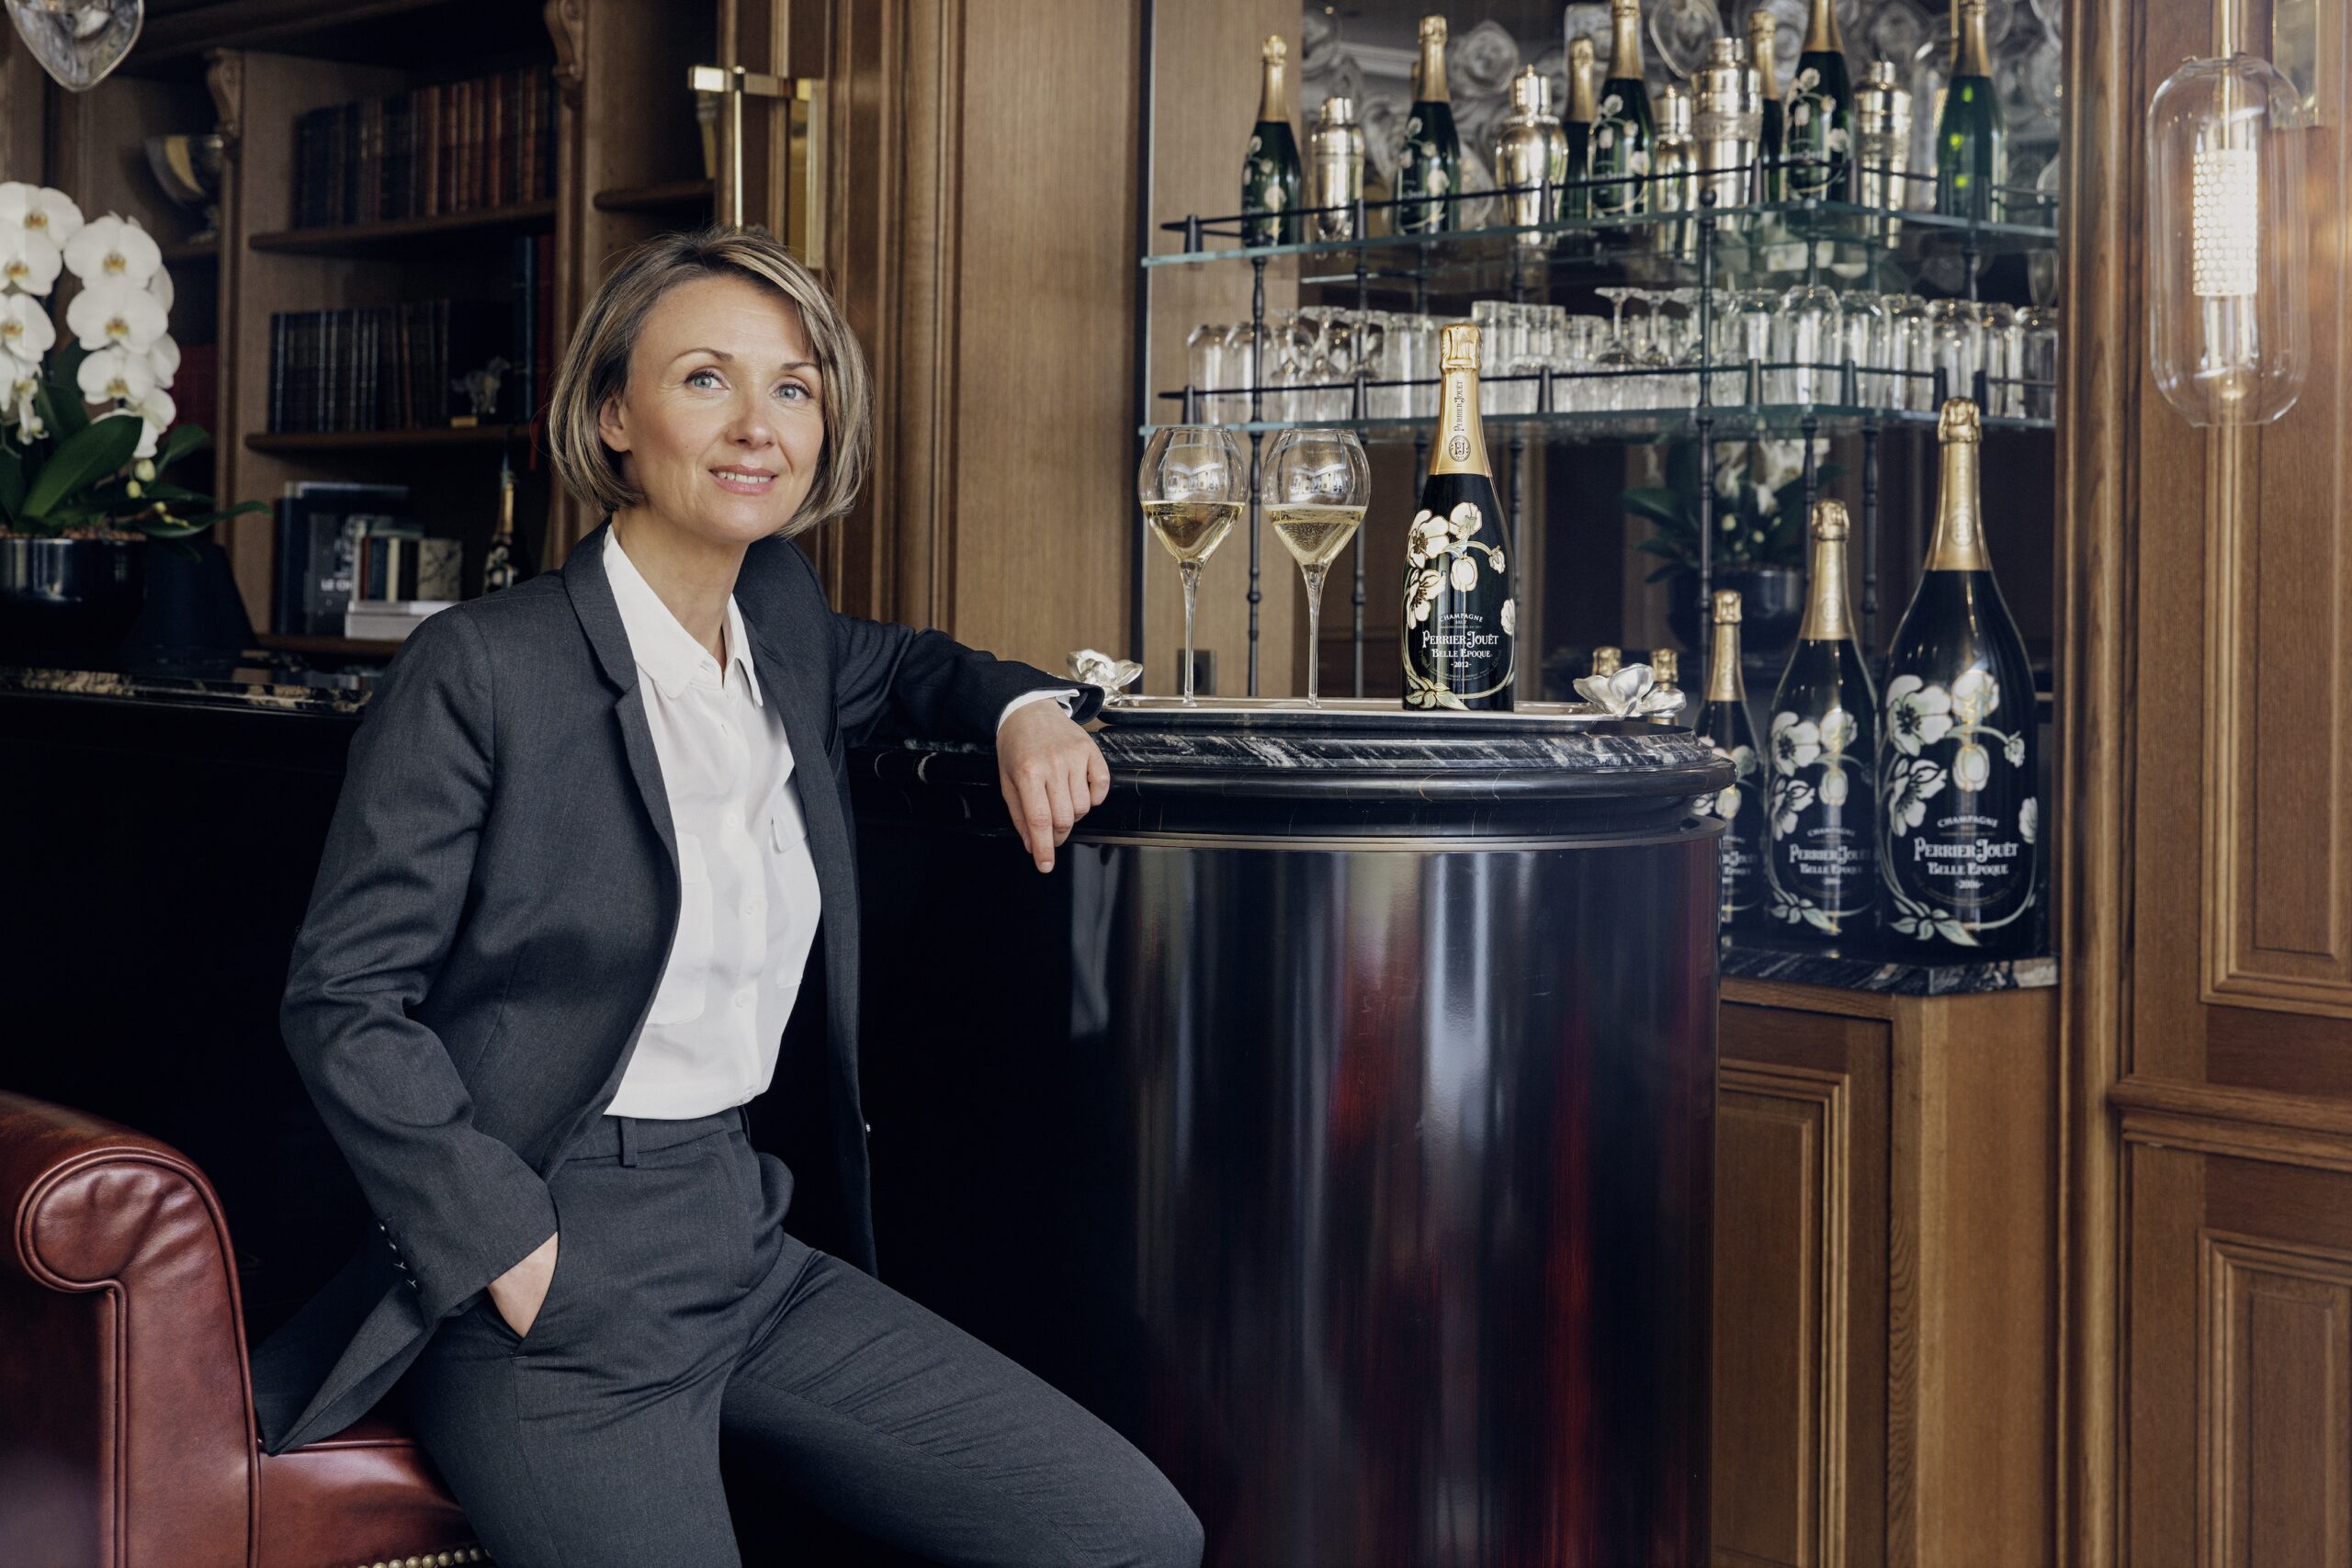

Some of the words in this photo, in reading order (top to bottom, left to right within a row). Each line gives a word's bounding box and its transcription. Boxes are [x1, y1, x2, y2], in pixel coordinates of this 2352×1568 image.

[1440, 613, 1484, 623] CHAMPAGNE
[1431, 648, 1458, 658] BELLE
[1461, 648, 1491, 659] EPOQUE
[1937, 815, 1998, 828] CHAMPAGNE
[1927, 862, 1965, 875] BELLE
